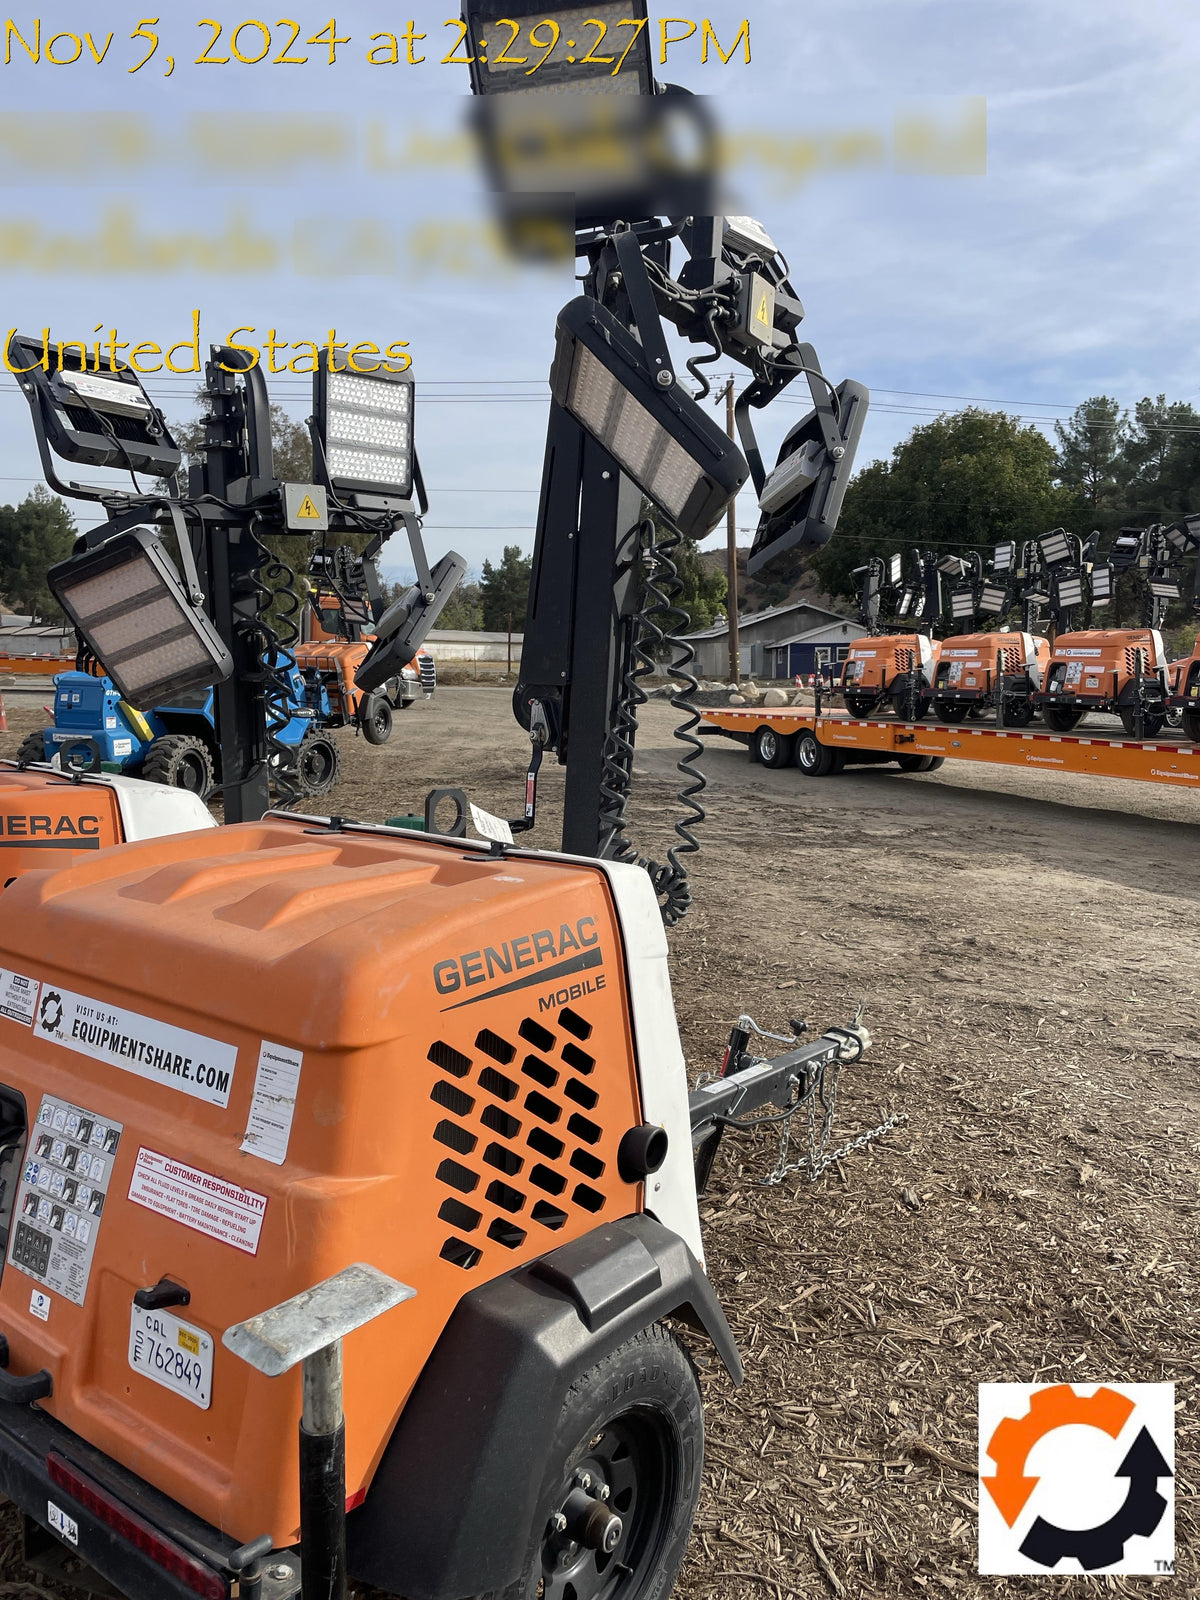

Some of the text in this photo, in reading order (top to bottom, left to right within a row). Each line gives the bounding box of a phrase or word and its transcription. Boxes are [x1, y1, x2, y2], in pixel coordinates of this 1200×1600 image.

[0, 815, 99, 836] ERAC
[433, 917, 598, 995] GENERAC
[76, 1004, 119, 1027] VISIT US AT:
[537, 974, 607, 1013] MOBILE
[71, 1018, 230, 1094] EQUIPMENTSHARE.COM
[267, 1053, 299, 1067] EquipmentShare
[138, 1171, 150, 1181] CHECK
[158, 1180, 169, 1189] FLUID
[170, 1185, 184, 1195] LEVELS
[188, 1193, 204, 1204] GREASE
[205, 1200, 217, 1209] DAILY
[218, 1205, 233, 1216] BEFORE
[234, 1212, 248, 1223] START
[249, 1218, 256, 1226] UP
[142, 1184, 246, 1234] INSURANCE FLAT TIRES TIRE DAMAGE REFUELING
[164, 1163, 264, 1210] CUSTOMER RESPONSIBILITY
[131, 1190, 147, 1202] DAMAGE
[153, 1200, 176, 1215] EQUIPMENT
[179, 1211, 196, 1223] BATTERY
[197, 1219, 228, 1238] MAINTENANCE
[231, 1234, 253, 1249] CLEANING
[146, 1315, 166, 1338] CAL
[147, 1336, 202, 1390] 762849
